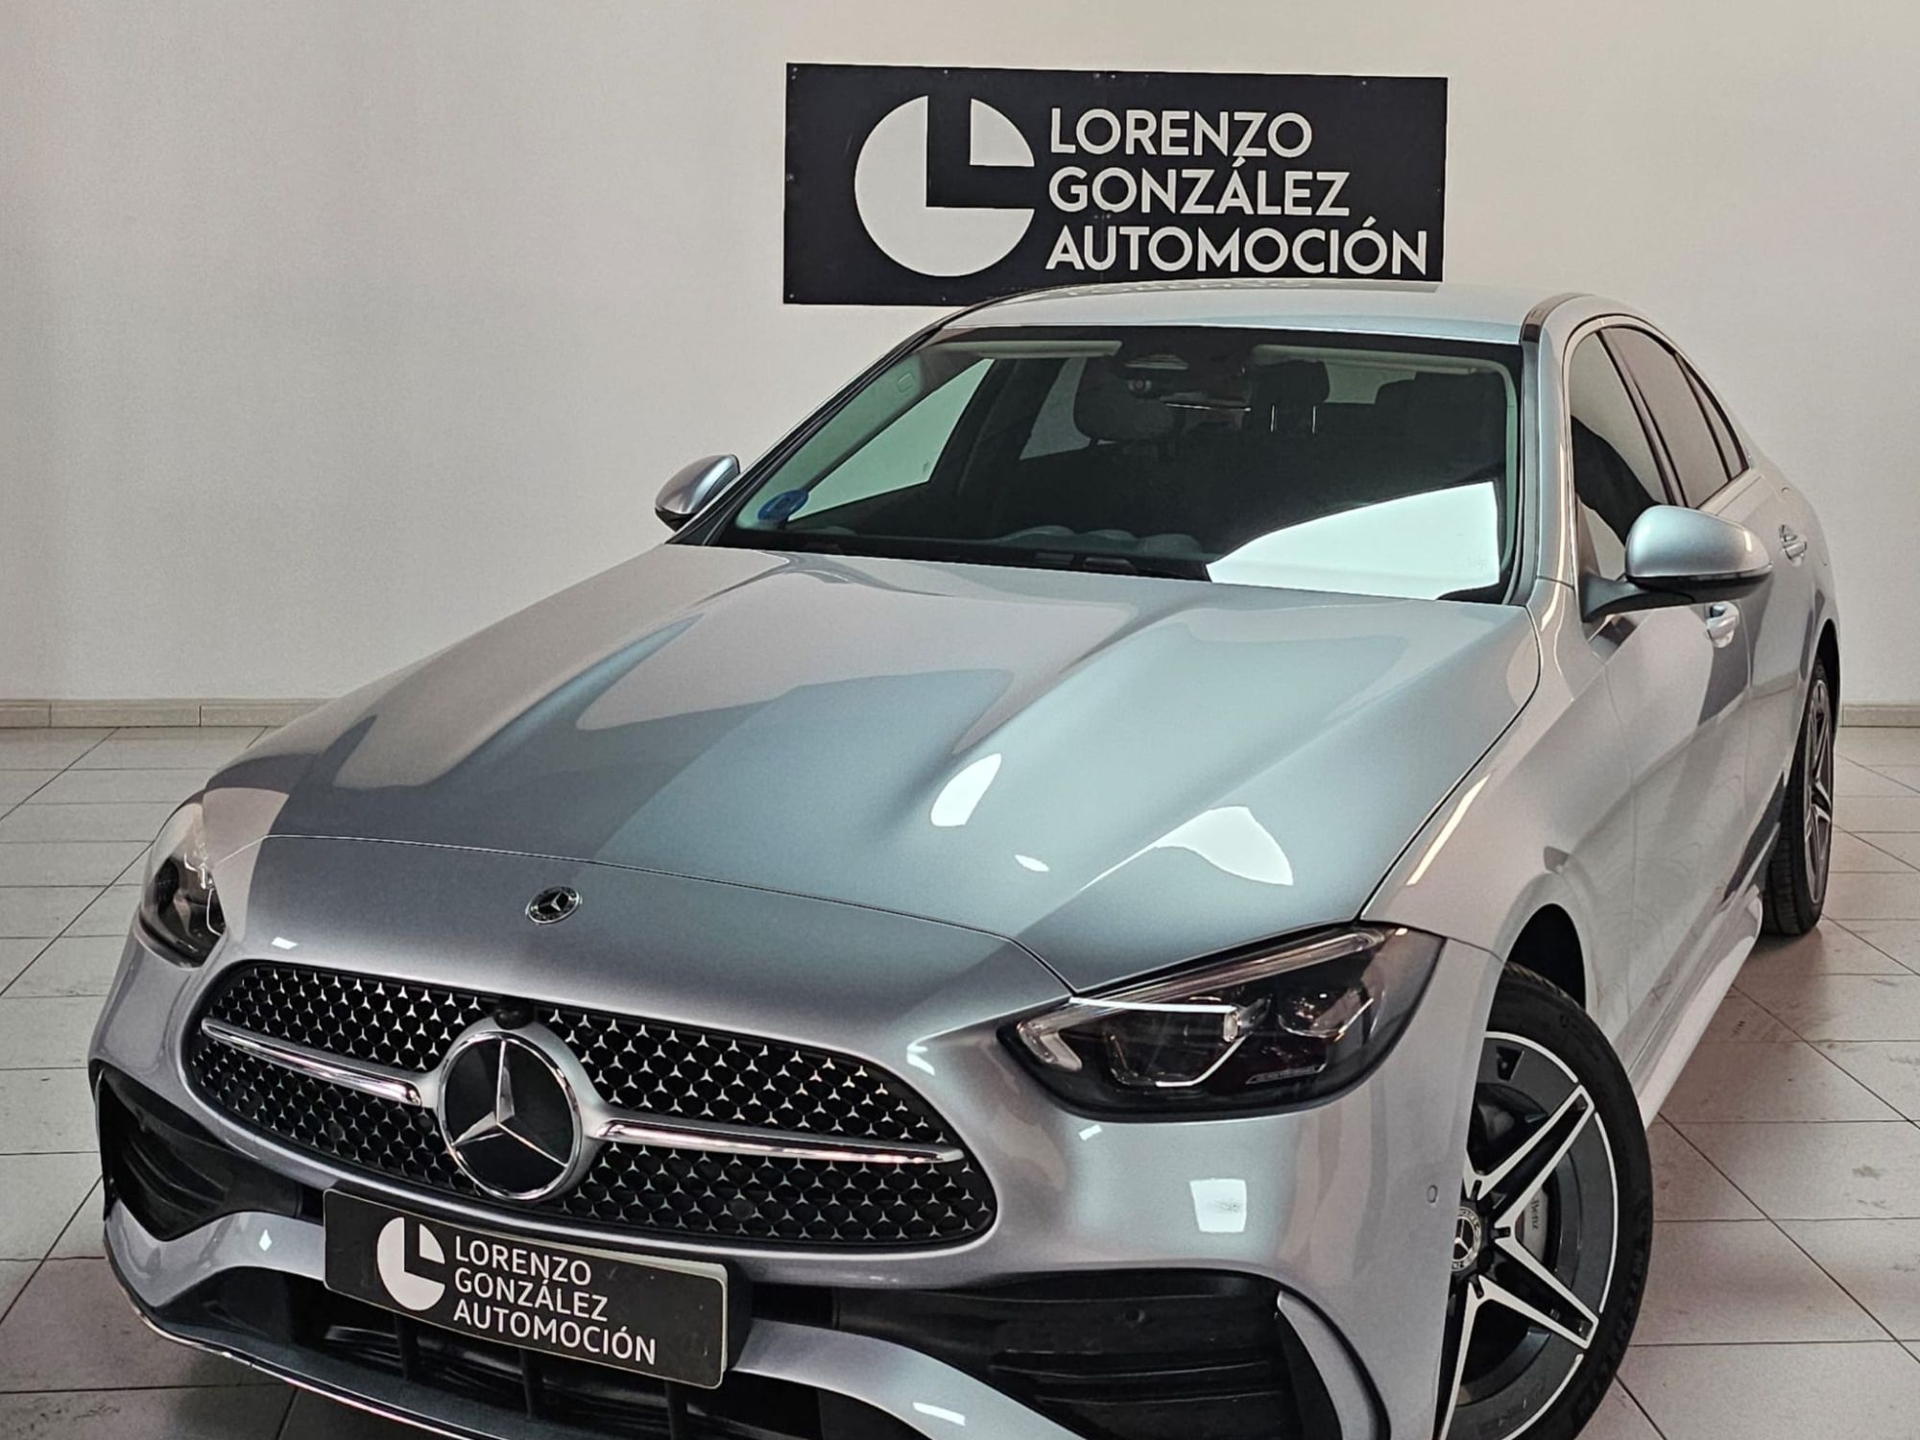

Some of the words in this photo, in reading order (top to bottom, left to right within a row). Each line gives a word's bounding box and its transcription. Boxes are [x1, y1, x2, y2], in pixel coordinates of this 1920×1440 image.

[1050, 107, 1313, 158] LORENZO
[1048, 156, 1350, 217] GONZÁLEZ
[1045, 215, 1428, 275] AUTOMOCIÓN
[455, 1235, 592, 1287] LORENZO
[454, 1267, 608, 1322] GONZÁLEZ
[453, 1298, 656, 1366] AUTOMOCIÓN
